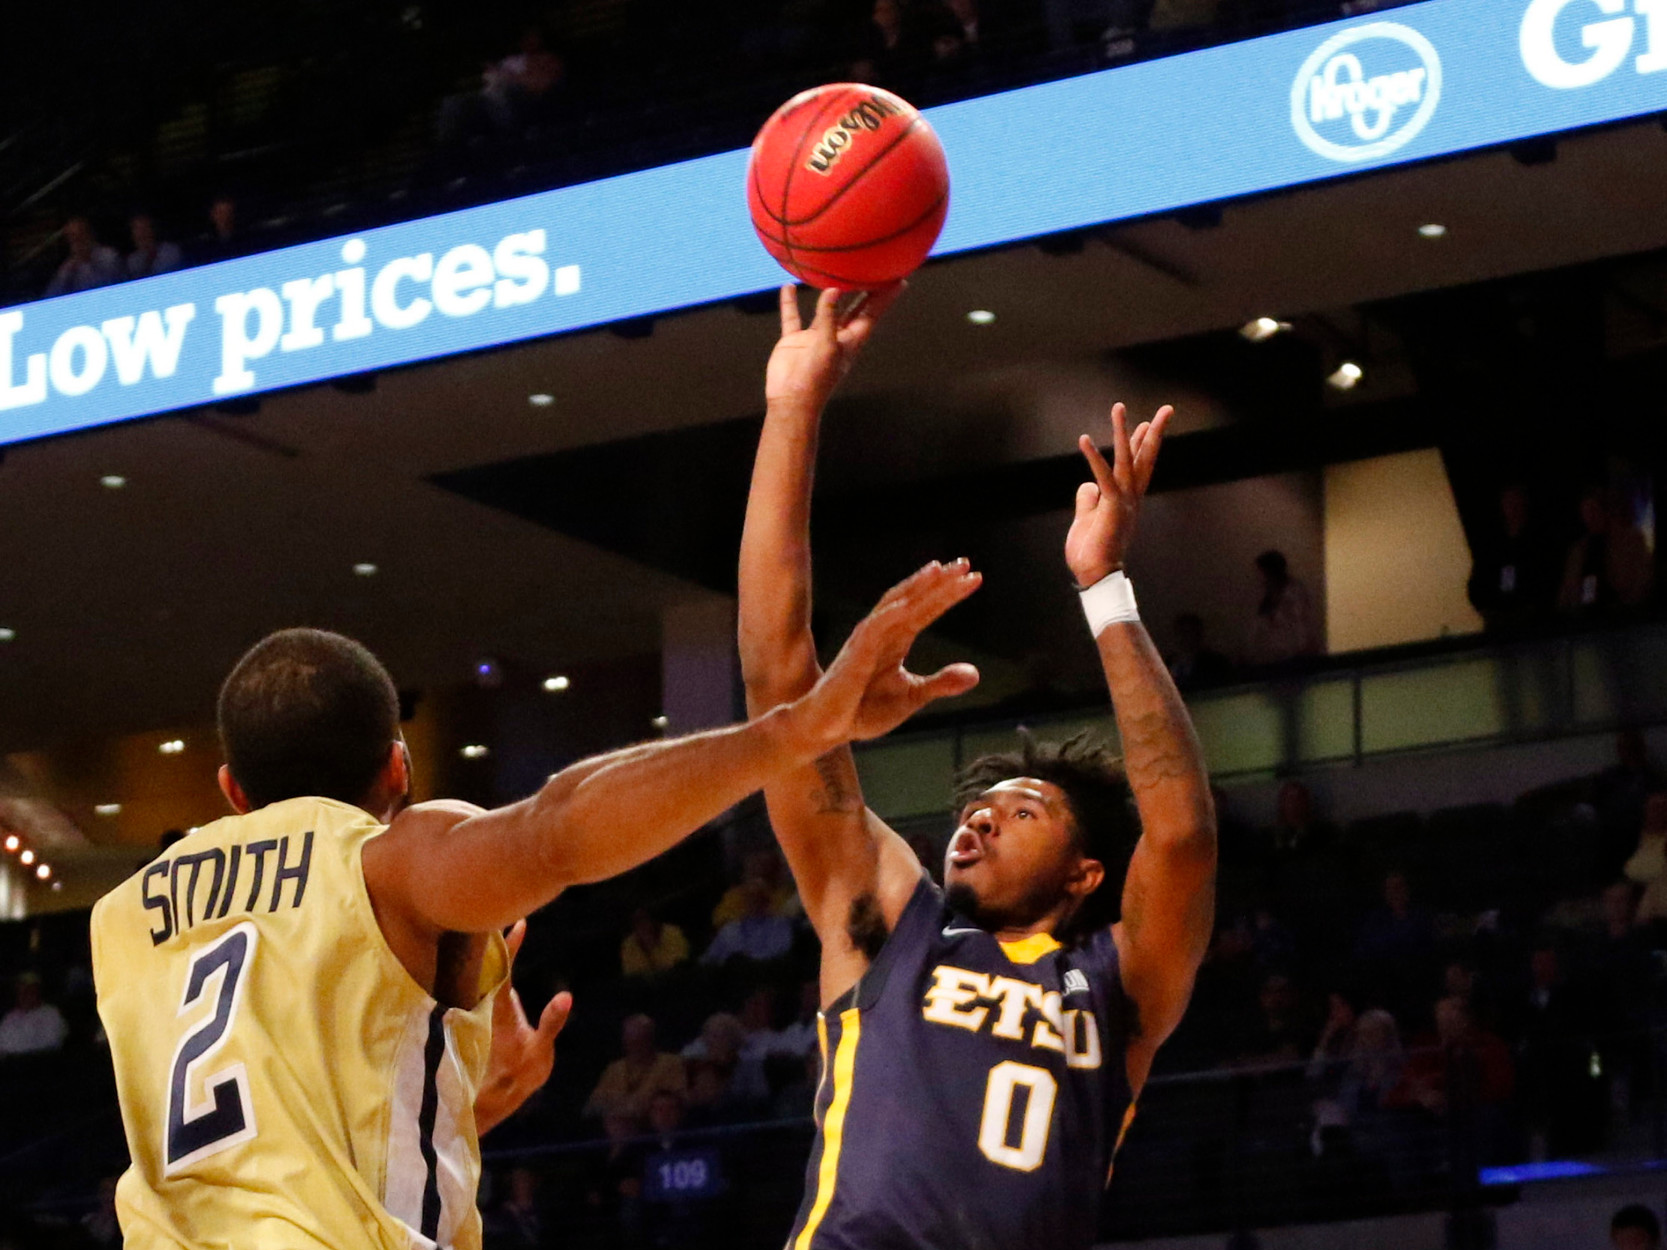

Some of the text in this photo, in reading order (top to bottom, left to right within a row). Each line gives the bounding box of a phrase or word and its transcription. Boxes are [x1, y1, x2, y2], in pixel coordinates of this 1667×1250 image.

[1310, 53, 1426, 141] Kroger
[0, 229, 582, 409] Low prices.
[142, 831, 316, 947] SMITH
[163, 921, 259, 1181] 2
[922, 964, 1102, 1069] ETSU
